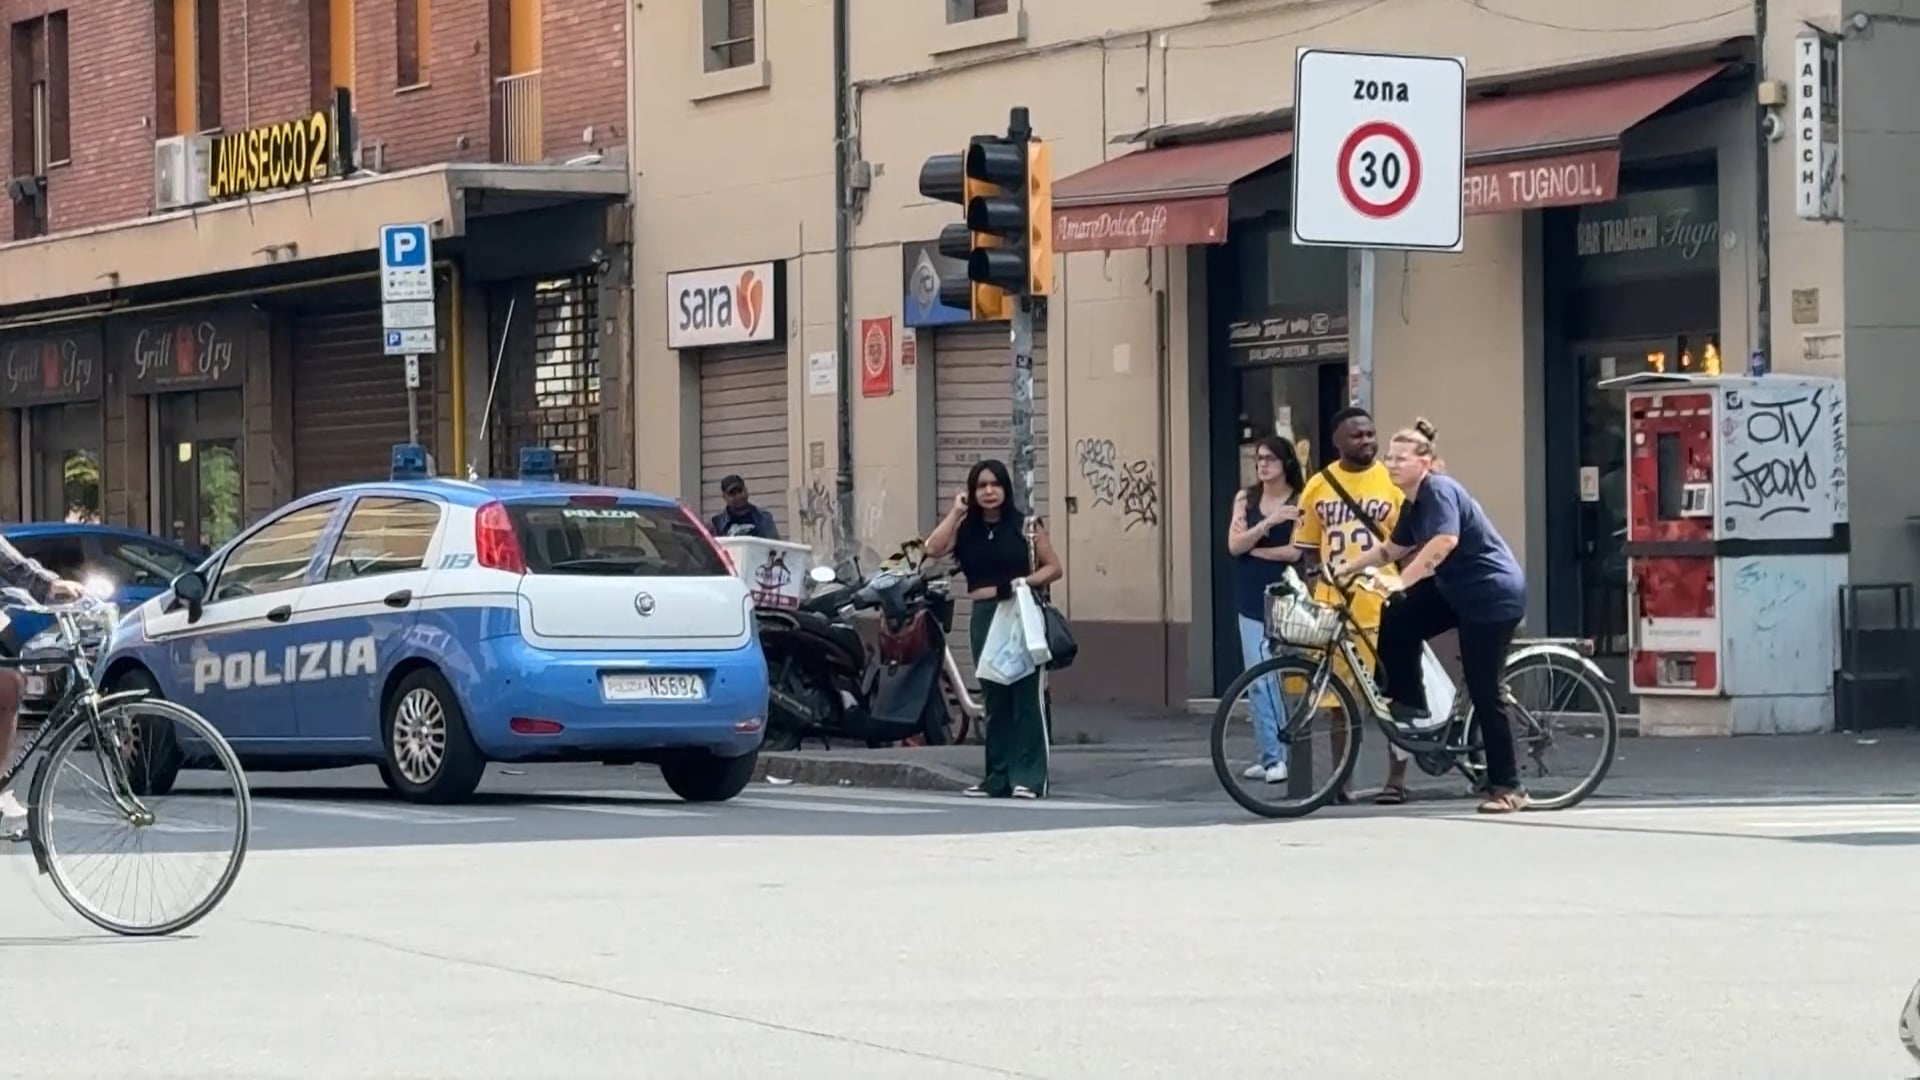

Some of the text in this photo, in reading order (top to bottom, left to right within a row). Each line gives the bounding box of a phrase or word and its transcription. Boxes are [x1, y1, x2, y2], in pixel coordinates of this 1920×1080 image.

[1353, 79, 1409, 102] zona
[1801, 42, 1814, 205] TABACCHI
[208, 110, 327, 197] LAVASECCO 2
[1360, 150, 1400, 189] 30
[393, 232, 417, 263] P
[1577, 222, 1600, 256] BAR
[1602, 215, 1657, 253] TABACCHI
[679, 285, 732, 331] sara
[134, 329, 172, 380] Grill
[563, 508, 641, 519] POLIZIA
[439, 553, 475, 569] 113
[194, 635, 377, 694] POLIZIA
